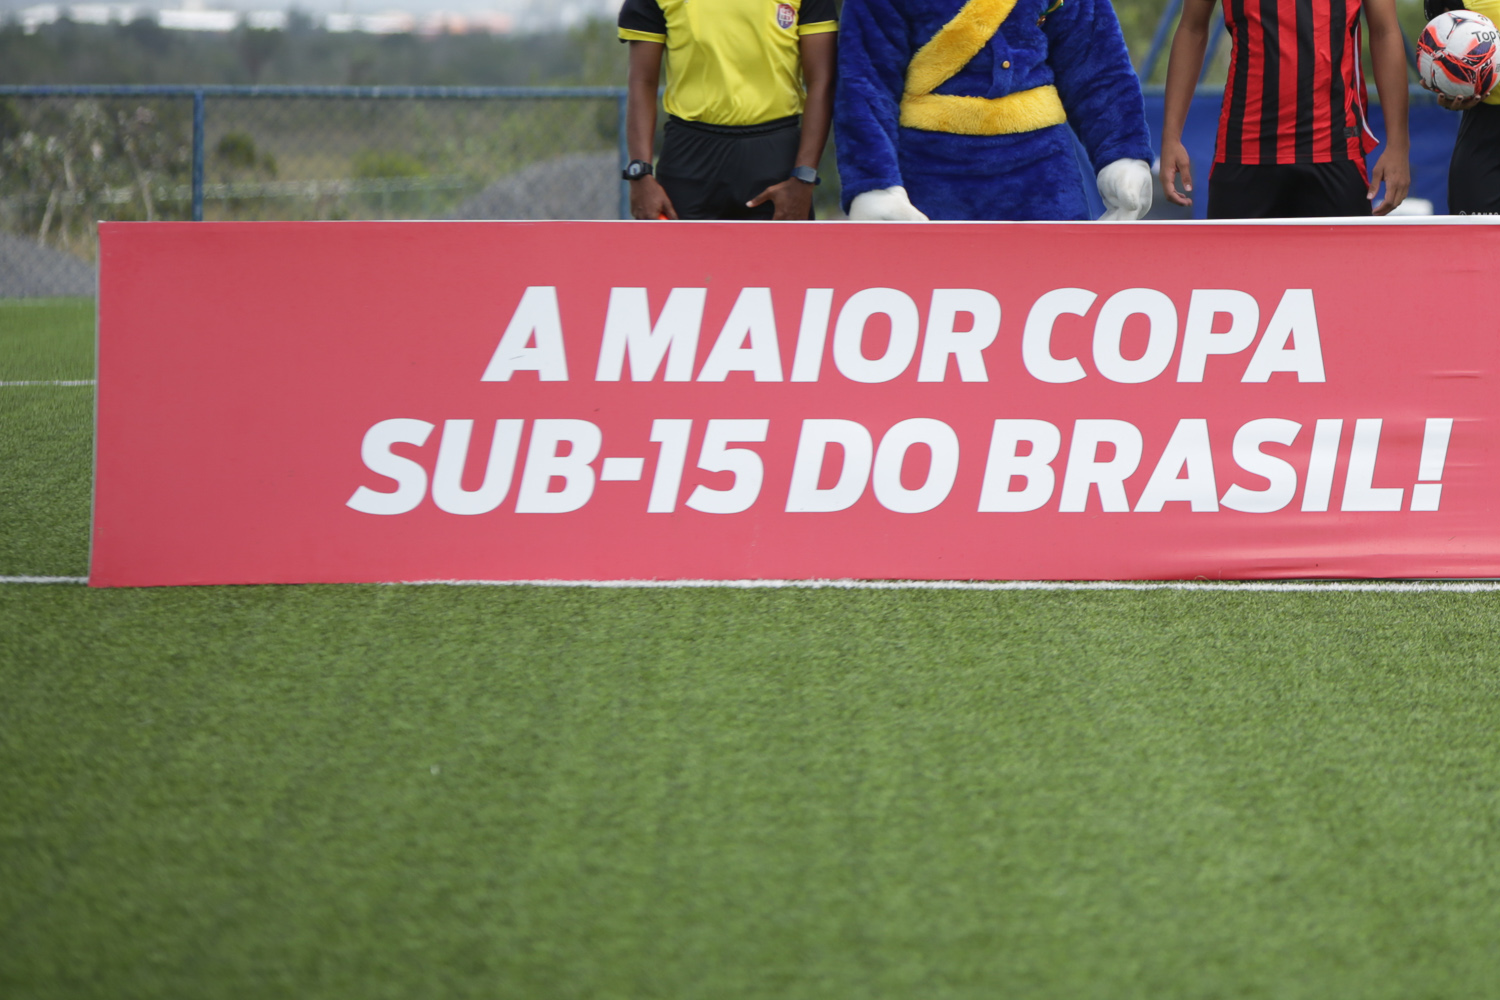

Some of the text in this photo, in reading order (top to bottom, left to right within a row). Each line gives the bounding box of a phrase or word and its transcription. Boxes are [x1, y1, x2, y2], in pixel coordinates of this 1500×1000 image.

[480, 285, 1328, 384] A MAIOR COPA
[345, 417, 1455, 517] SUB-15 DO BRASIL!
